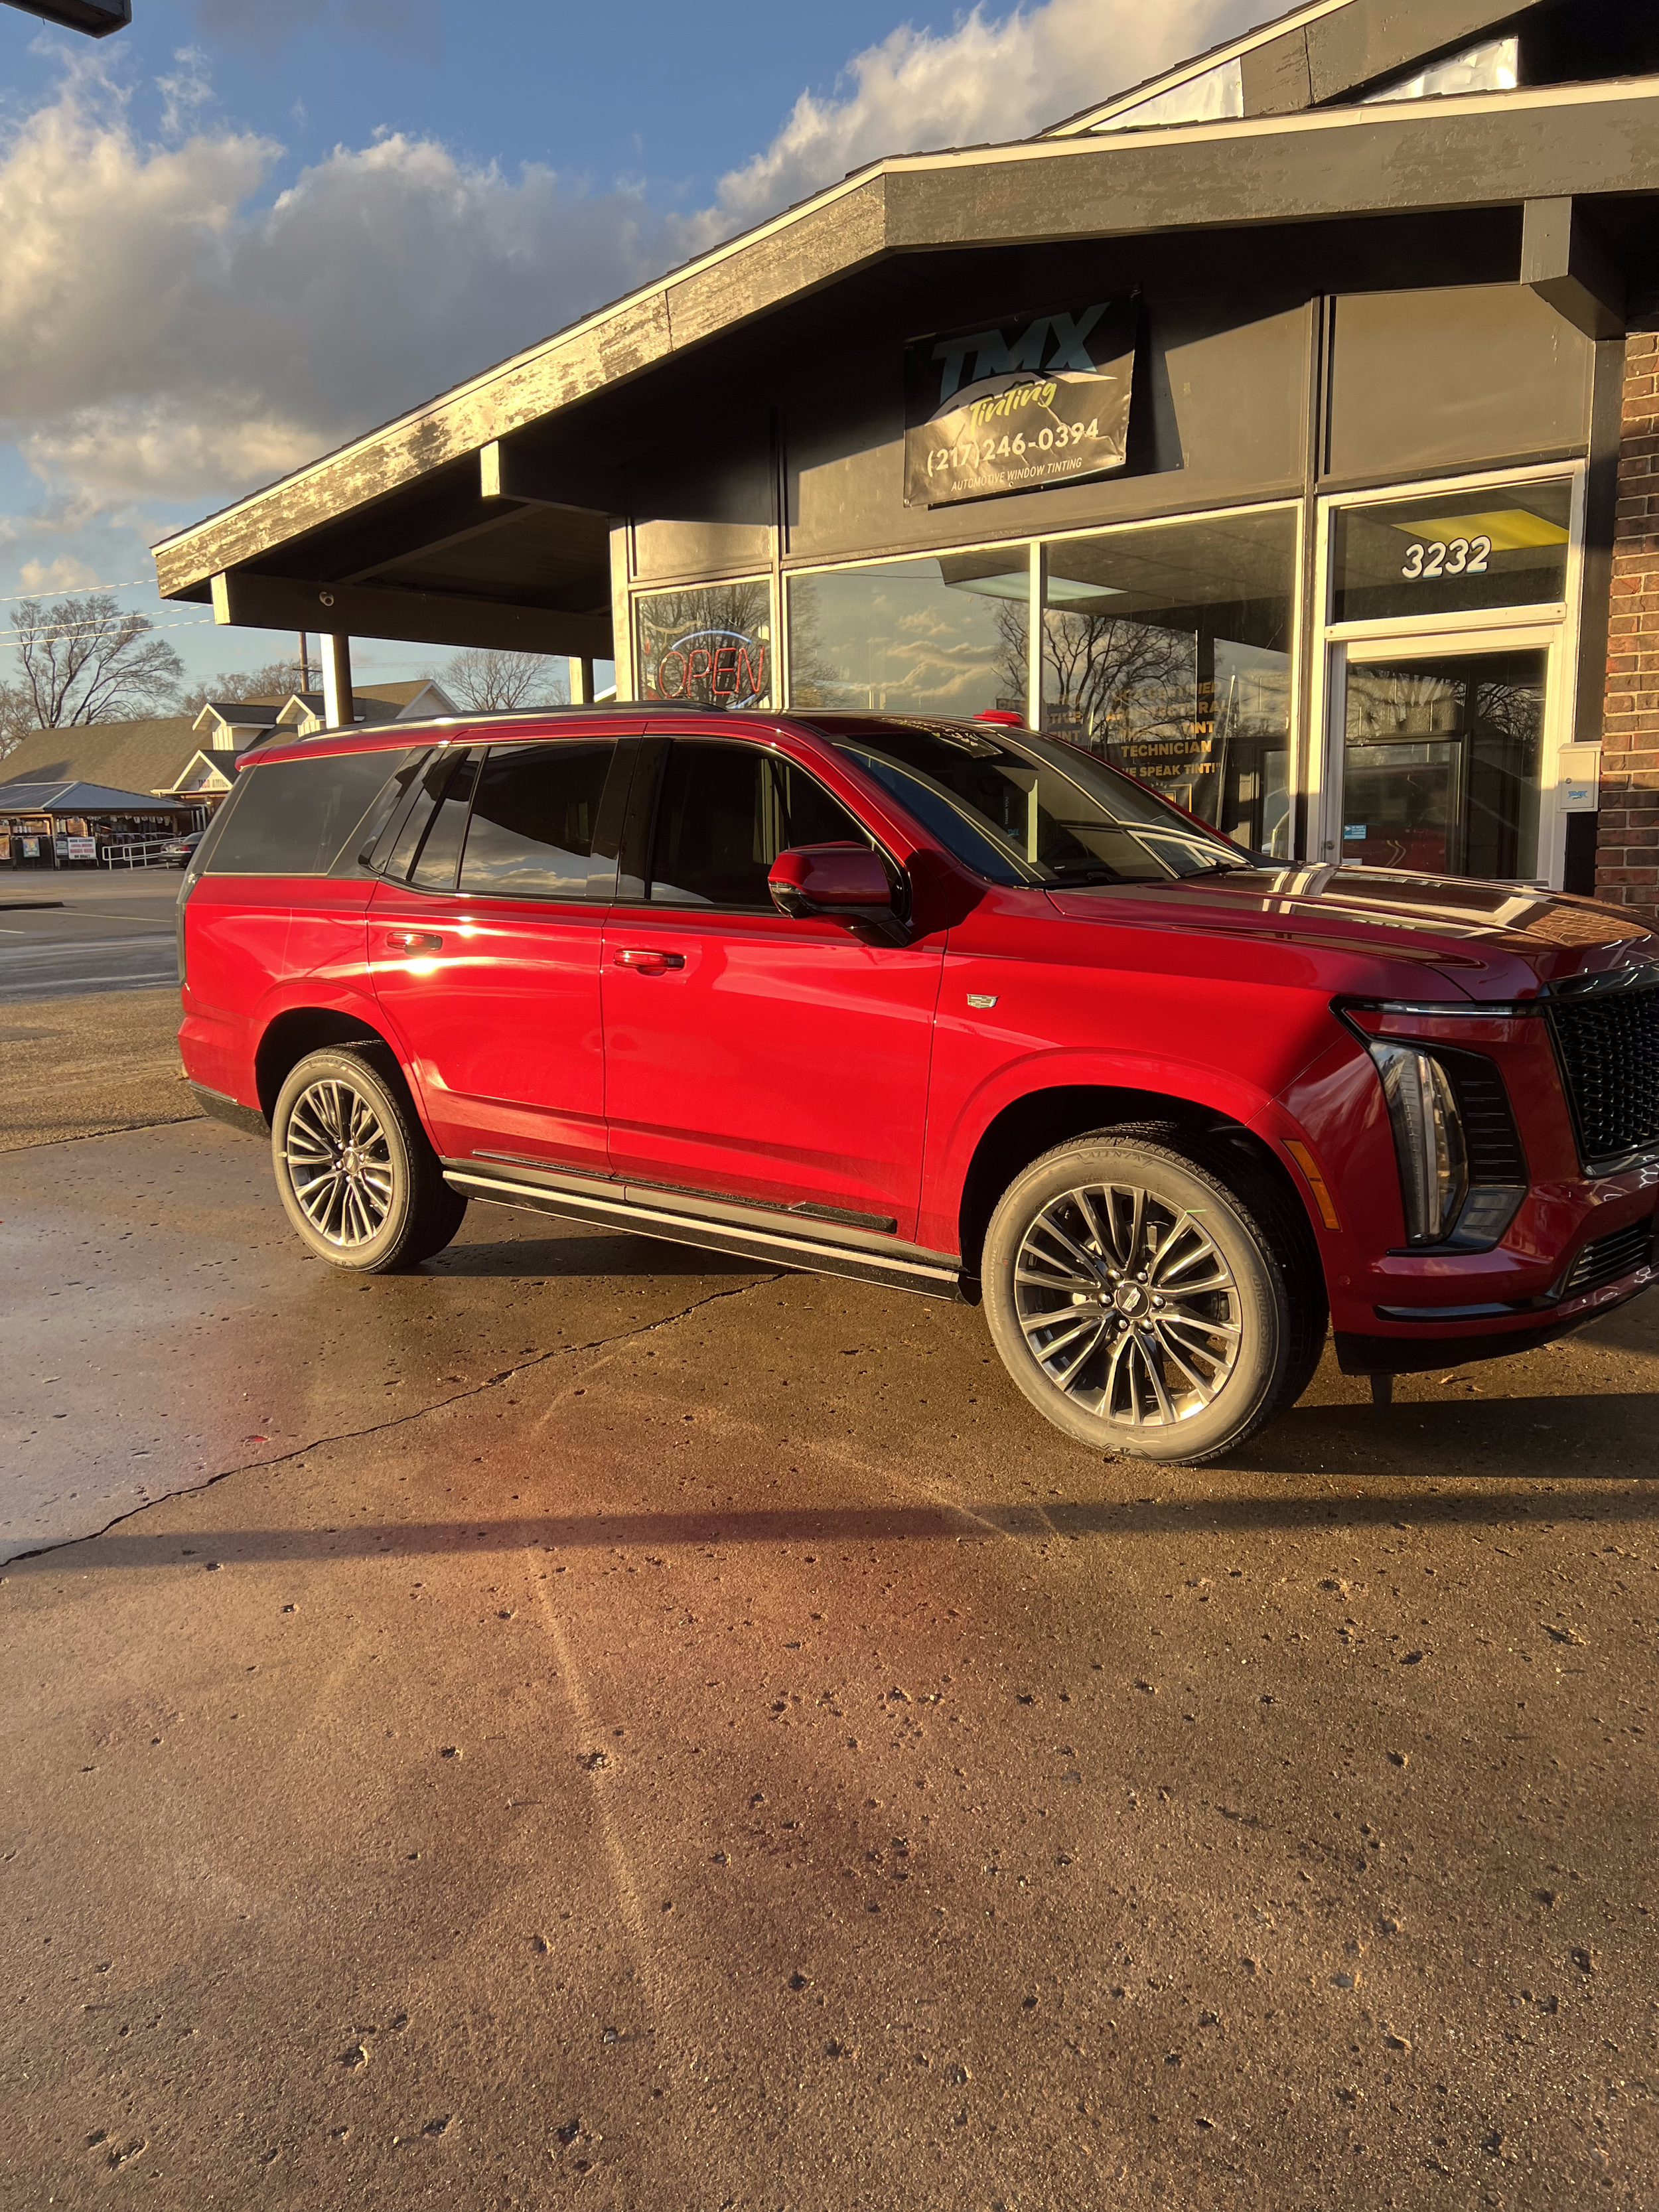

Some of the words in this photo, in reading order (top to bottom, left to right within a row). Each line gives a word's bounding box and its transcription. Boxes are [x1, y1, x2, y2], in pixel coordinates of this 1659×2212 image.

[932, 301, 1112, 405] TMX
[951, 472, 1005, 492] AUTOMOTIVE
[1007, 465, 1045, 481] WINDOW
[1047, 457, 1082, 474] TINTING
[1402, 535, 1492, 579] 3232
[659, 646, 764, 698] OPEN
[1121, 740, 1212, 758] TECHNICIAN
[1139, 765, 1181, 777] SPEAK
